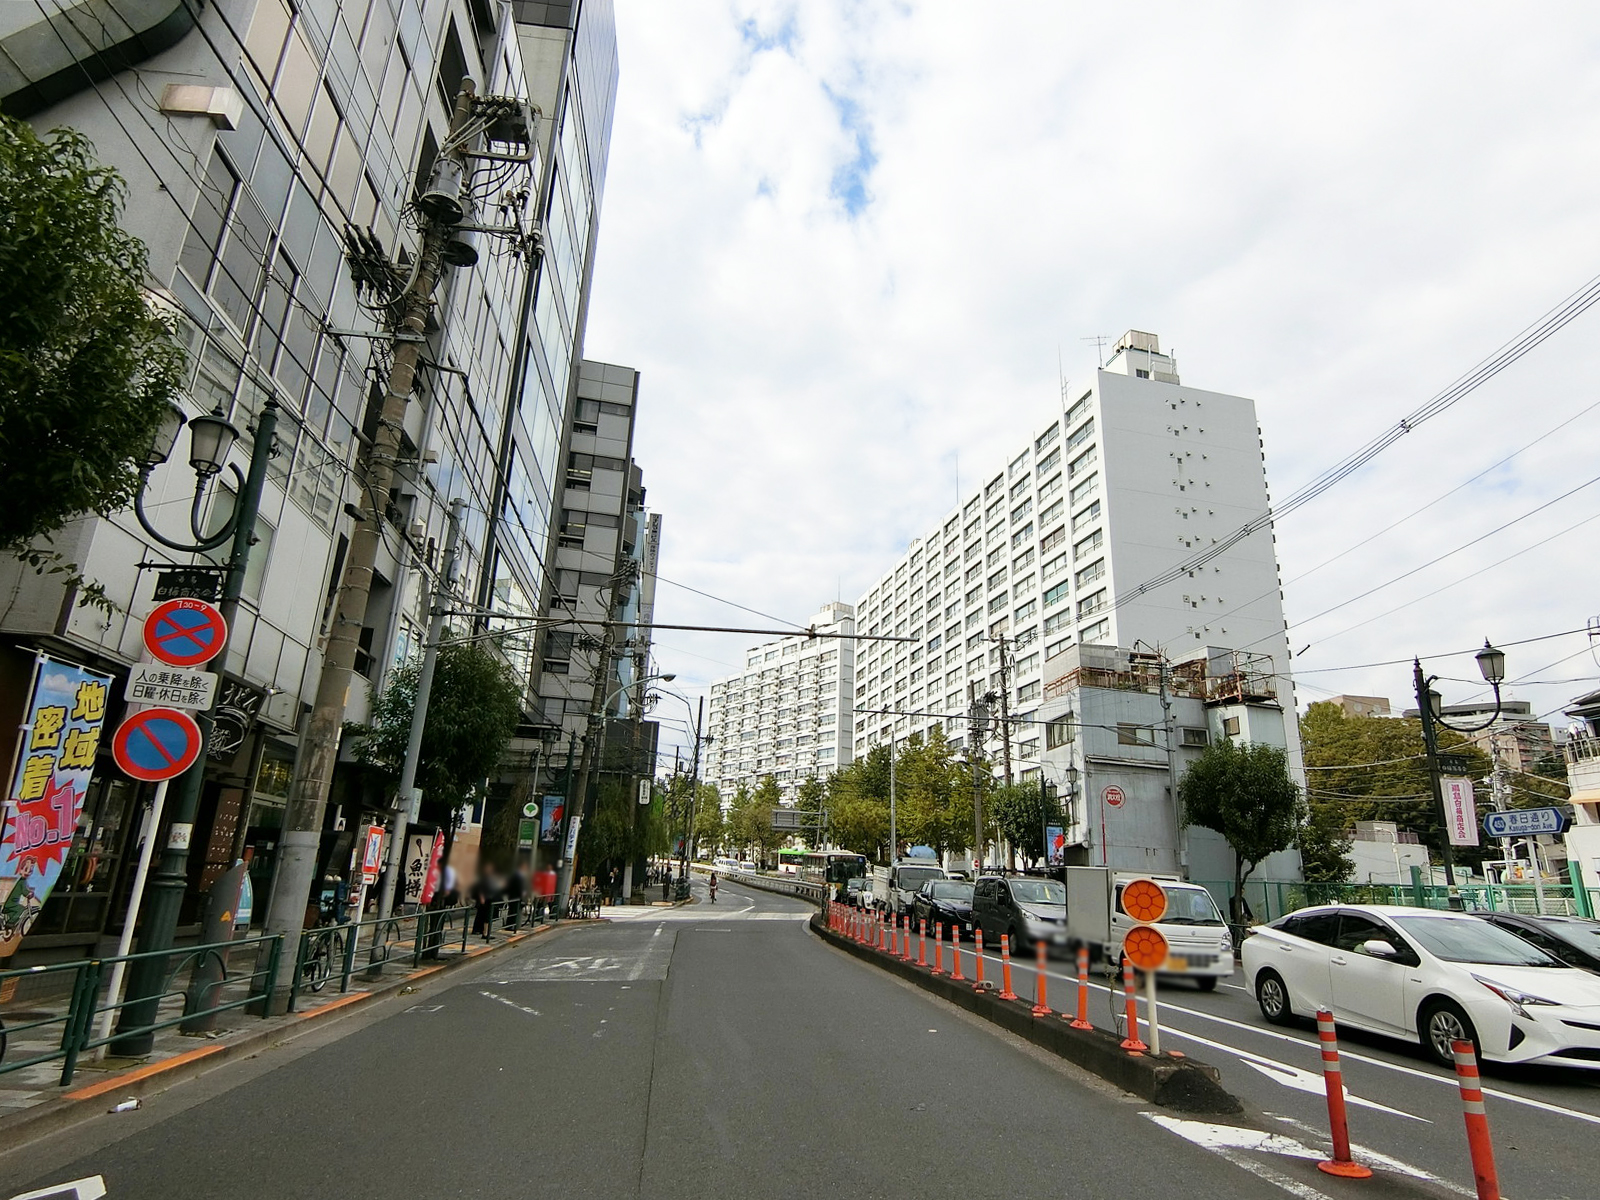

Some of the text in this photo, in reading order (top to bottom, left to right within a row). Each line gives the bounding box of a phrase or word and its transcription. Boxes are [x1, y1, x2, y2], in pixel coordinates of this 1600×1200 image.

[135, 668, 209, 690] 人の乗降を除く
[132, 684, 206, 705] 日曜・休日を除く
[224, 682, 258, 716] うどん
[58, 680, 107, 772] 地域
[19, 704, 68, 803] 密着
[14, 786, 76, 854] No.1
[1509, 811, 1550, 824] 春日通り
[1509, 822, 1555, 832] Kasuga-dori Ave.
